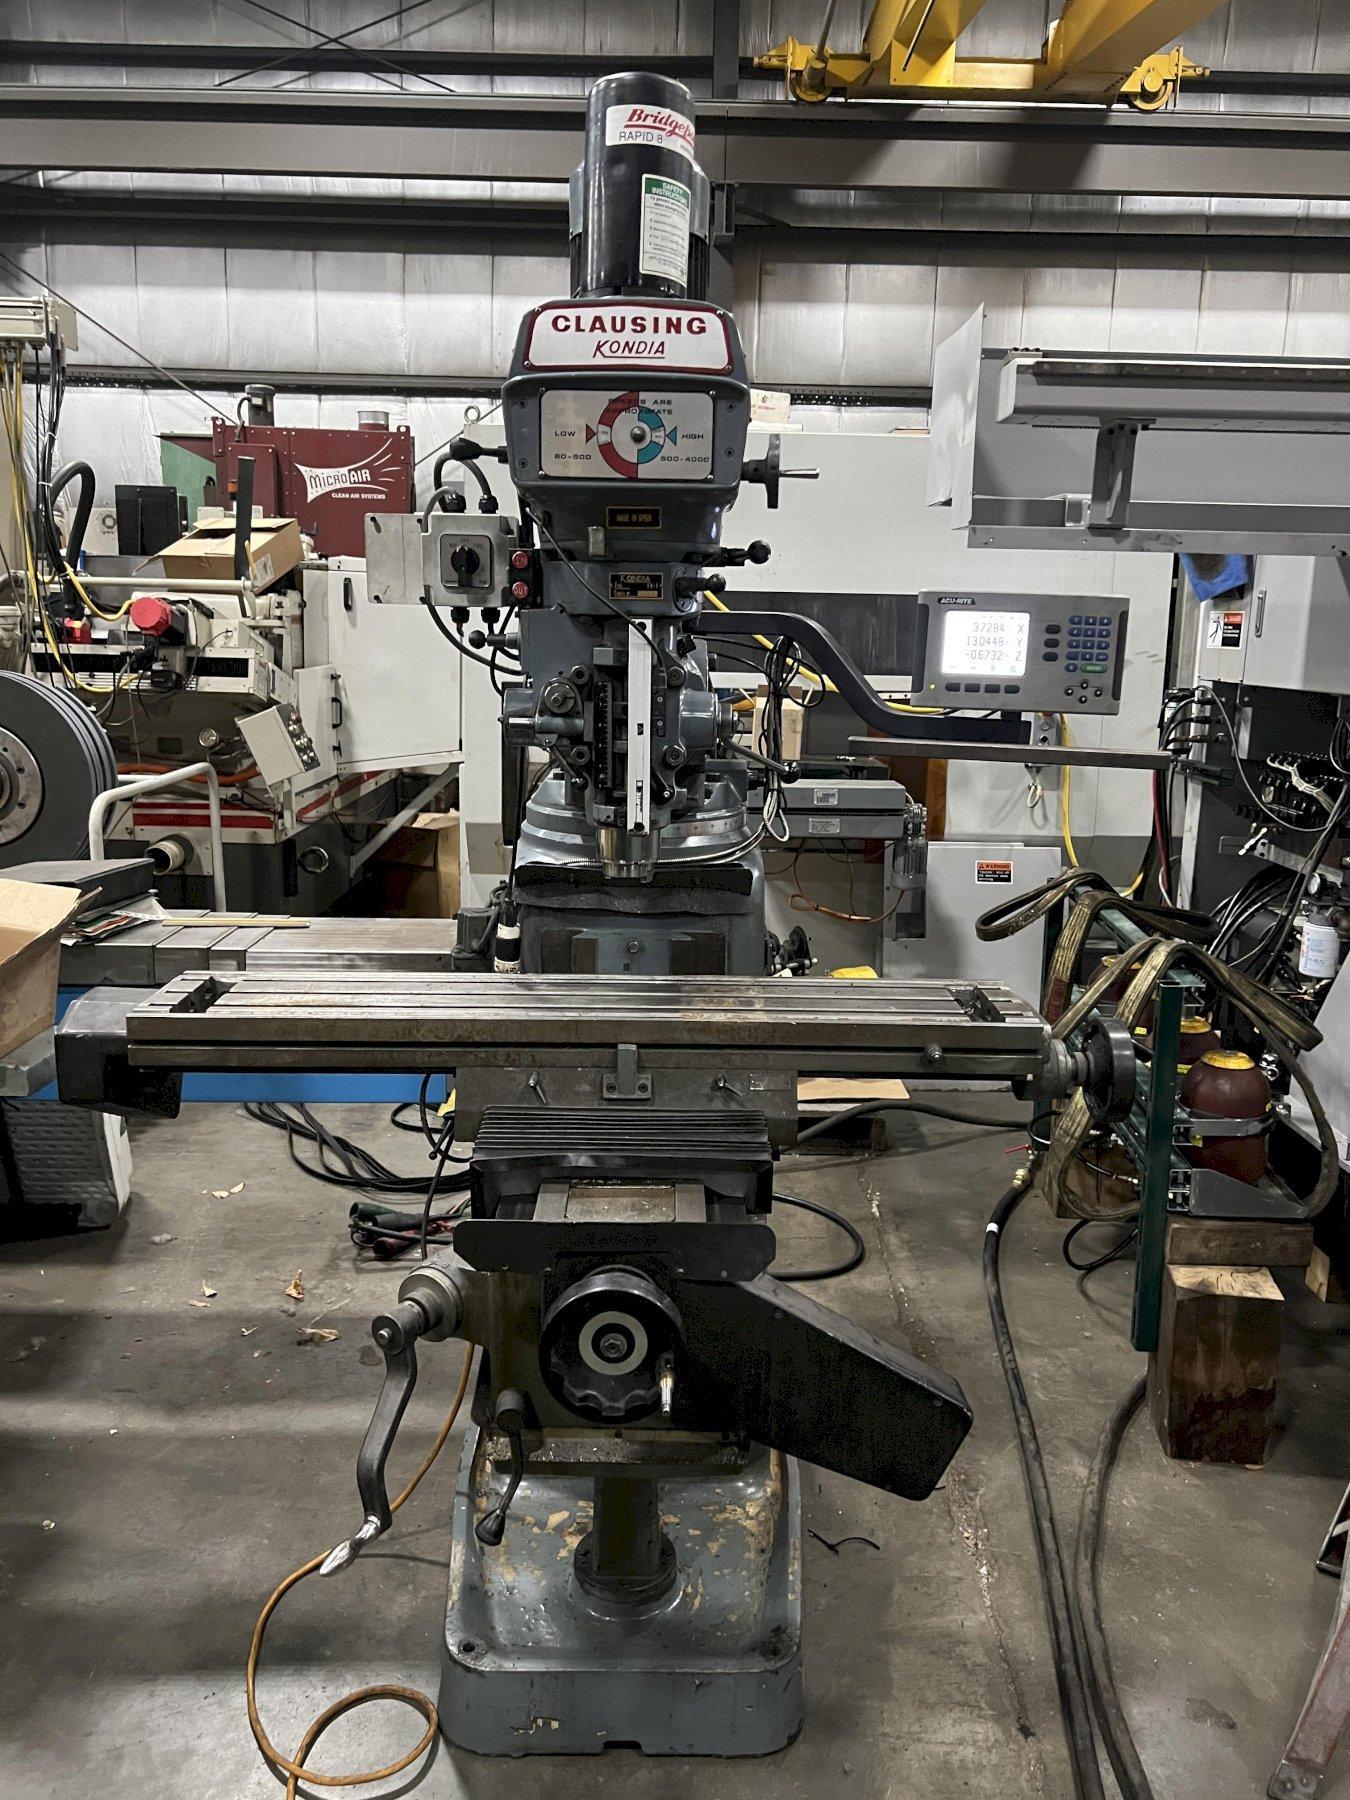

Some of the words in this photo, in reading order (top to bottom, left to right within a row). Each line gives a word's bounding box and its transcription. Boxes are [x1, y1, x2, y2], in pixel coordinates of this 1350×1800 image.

[619, 131, 654, 142] RAPID
[662, 182, 683, 195] SAFETY
[551, 315, 707, 335] CLAUSING
[592, 340, 665, 359] KONDIA
[620, 574, 651, 583] KONDIA
[514, 585, 528, 595] OUT
[940, 597, 973, 605] ACU-RITE
[1017, 623, 1024, 634] X
[1016, 637, 1023, 648] Y
[1015, 650, 1023, 662] Z
